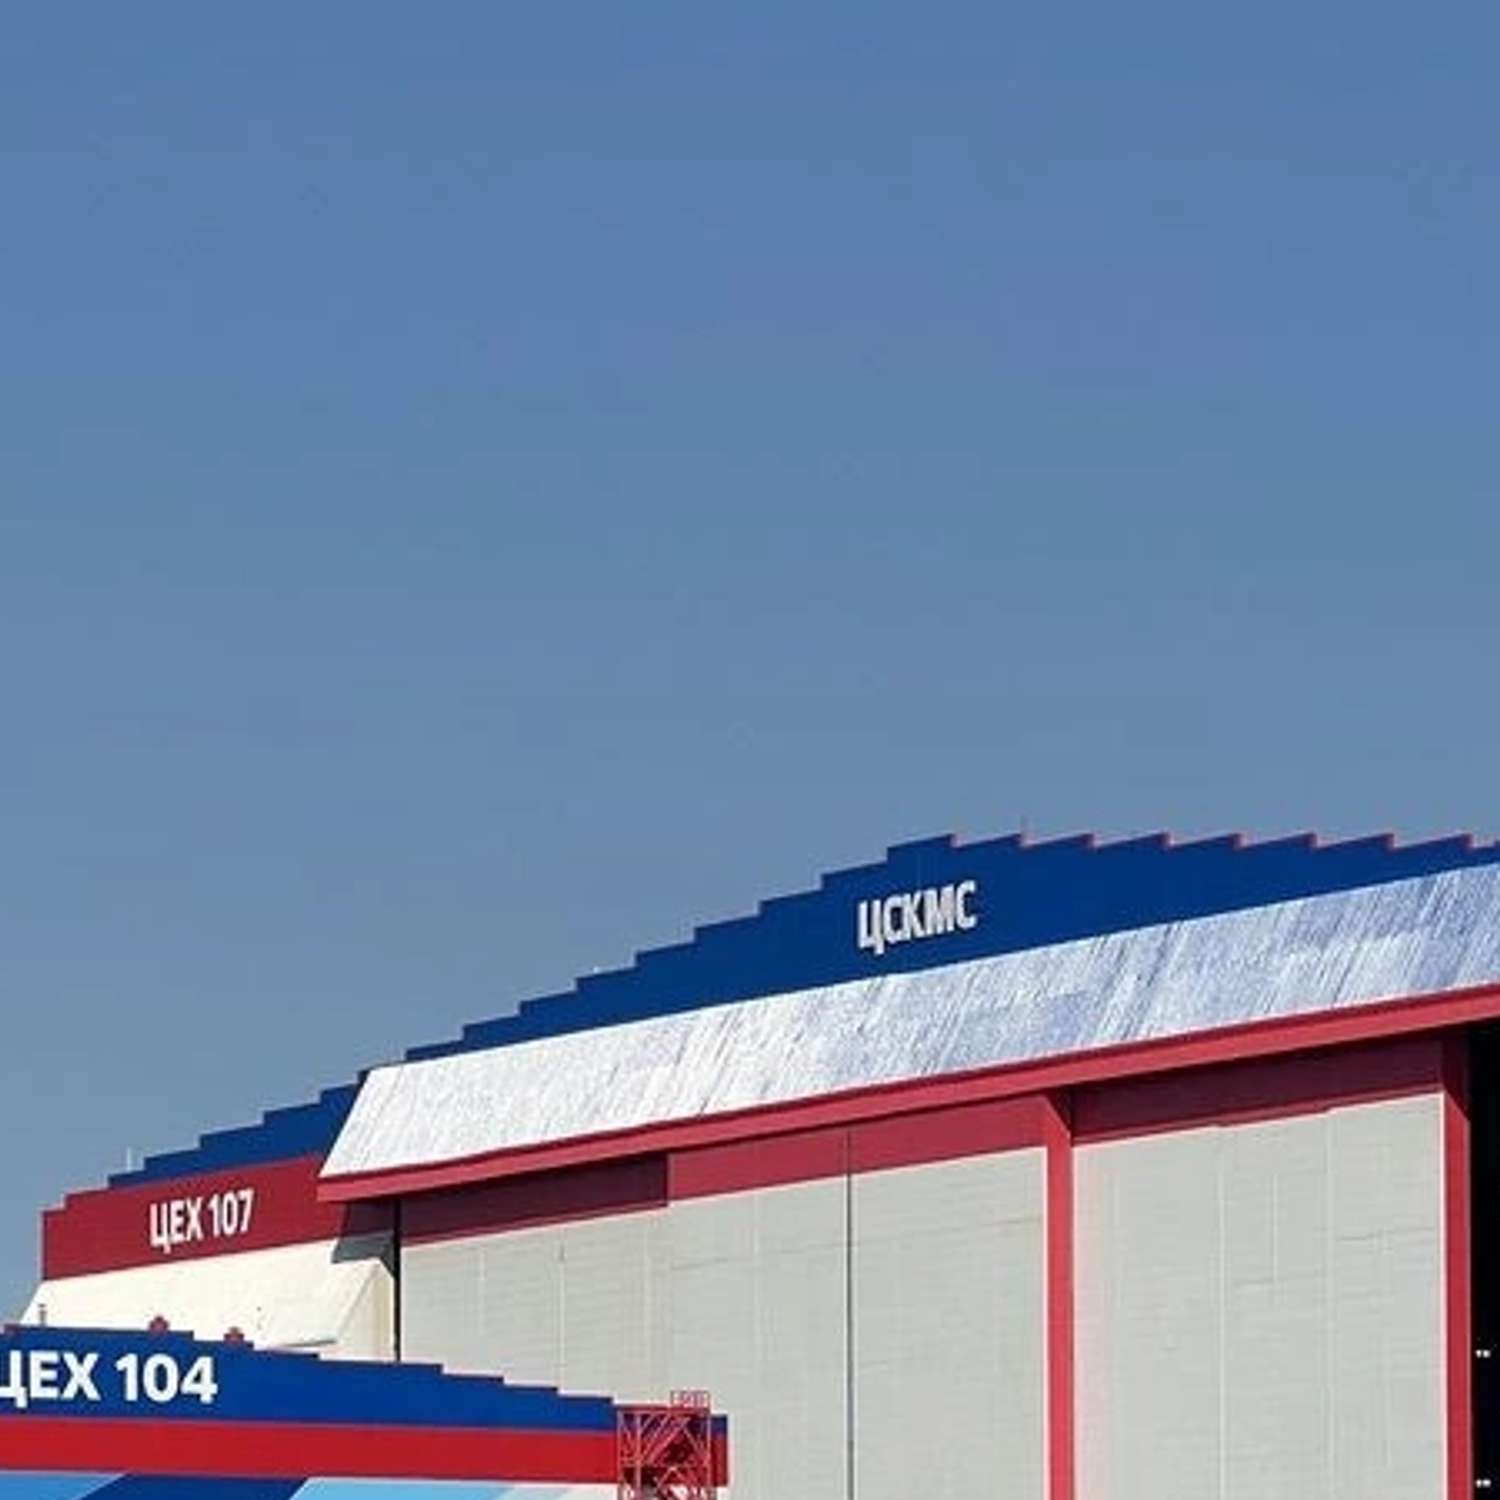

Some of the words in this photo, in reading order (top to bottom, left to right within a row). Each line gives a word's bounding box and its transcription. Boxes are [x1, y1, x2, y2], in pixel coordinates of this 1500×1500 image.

[858, 880, 978, 954] ЦСКМС
[149, 1196, 203, 1253] ЦЕХ
[208, 1189, 254, 1239] 107
[0, 1353, 101, 1408] ЦЕХ
[116, 1354, 218, 1404] 104
